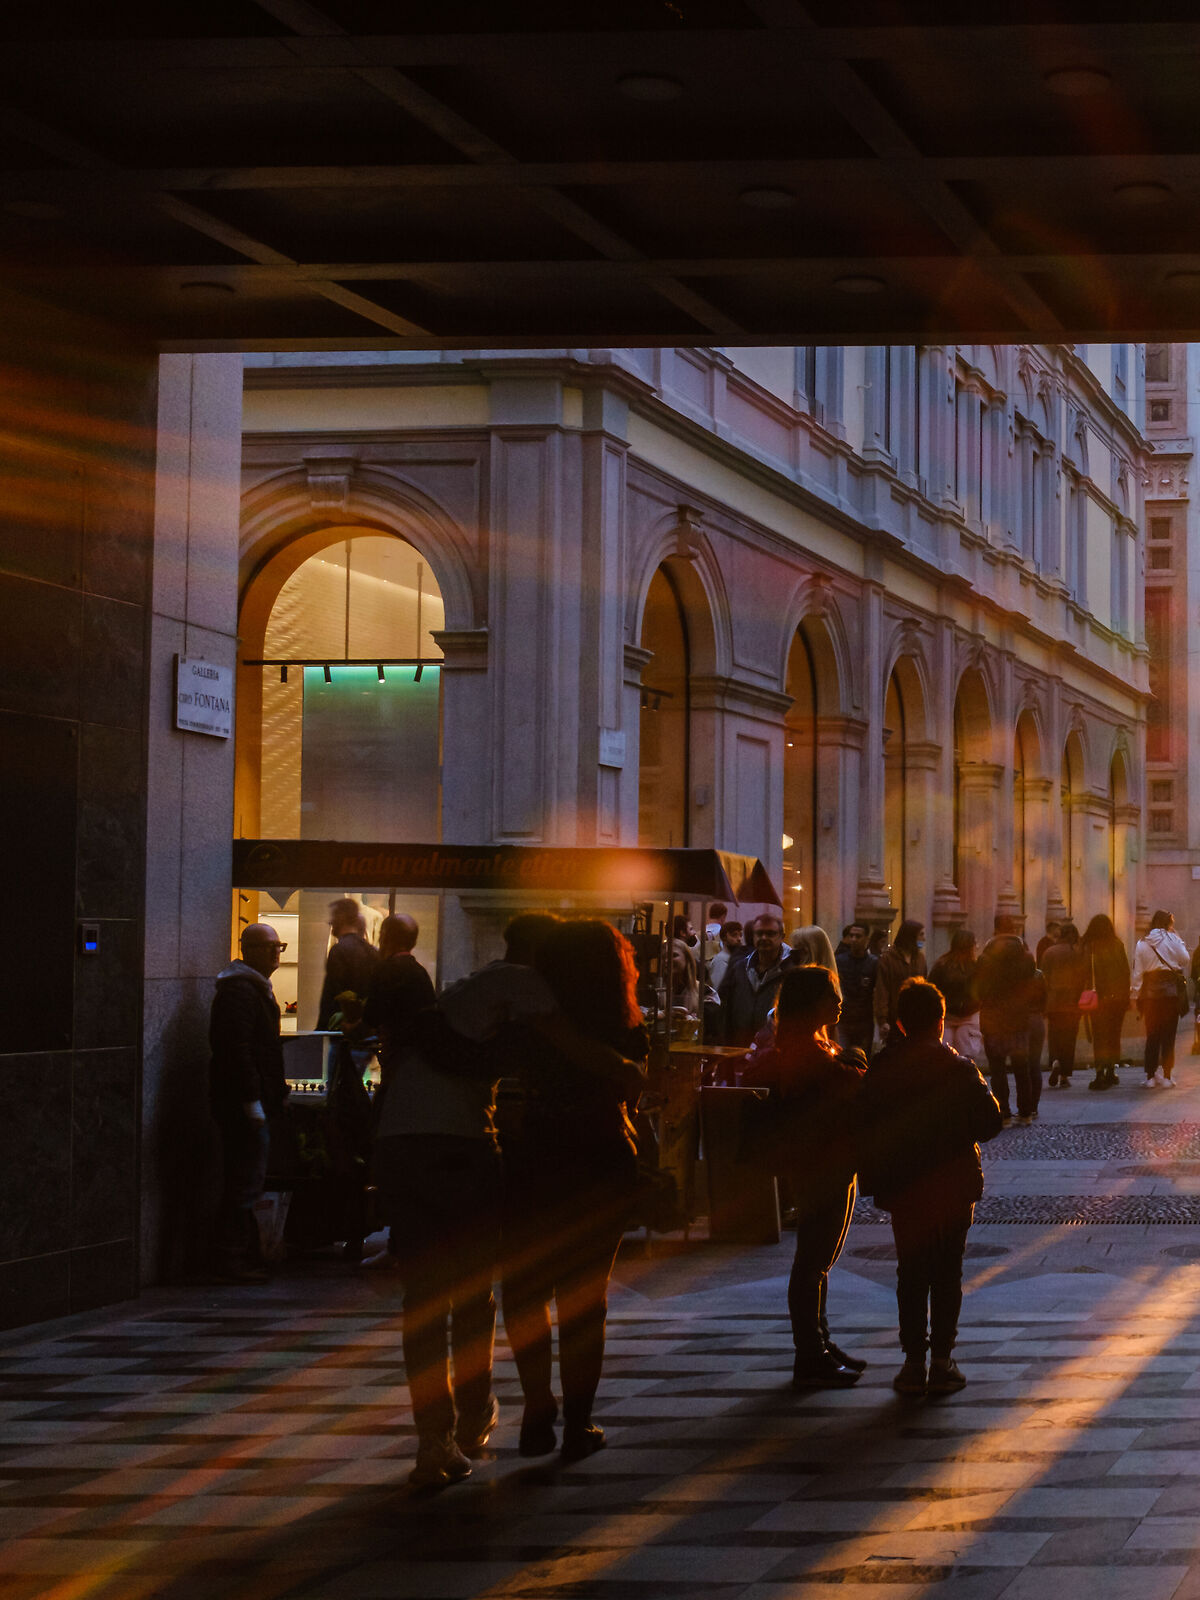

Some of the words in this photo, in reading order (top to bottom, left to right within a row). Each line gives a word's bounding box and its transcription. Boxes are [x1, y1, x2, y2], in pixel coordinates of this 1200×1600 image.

[192, 664, 219, 681] GALLERIA
[194, 692, 230, 713] FONTANA
[339, 851, 517, 877] naturalmente
